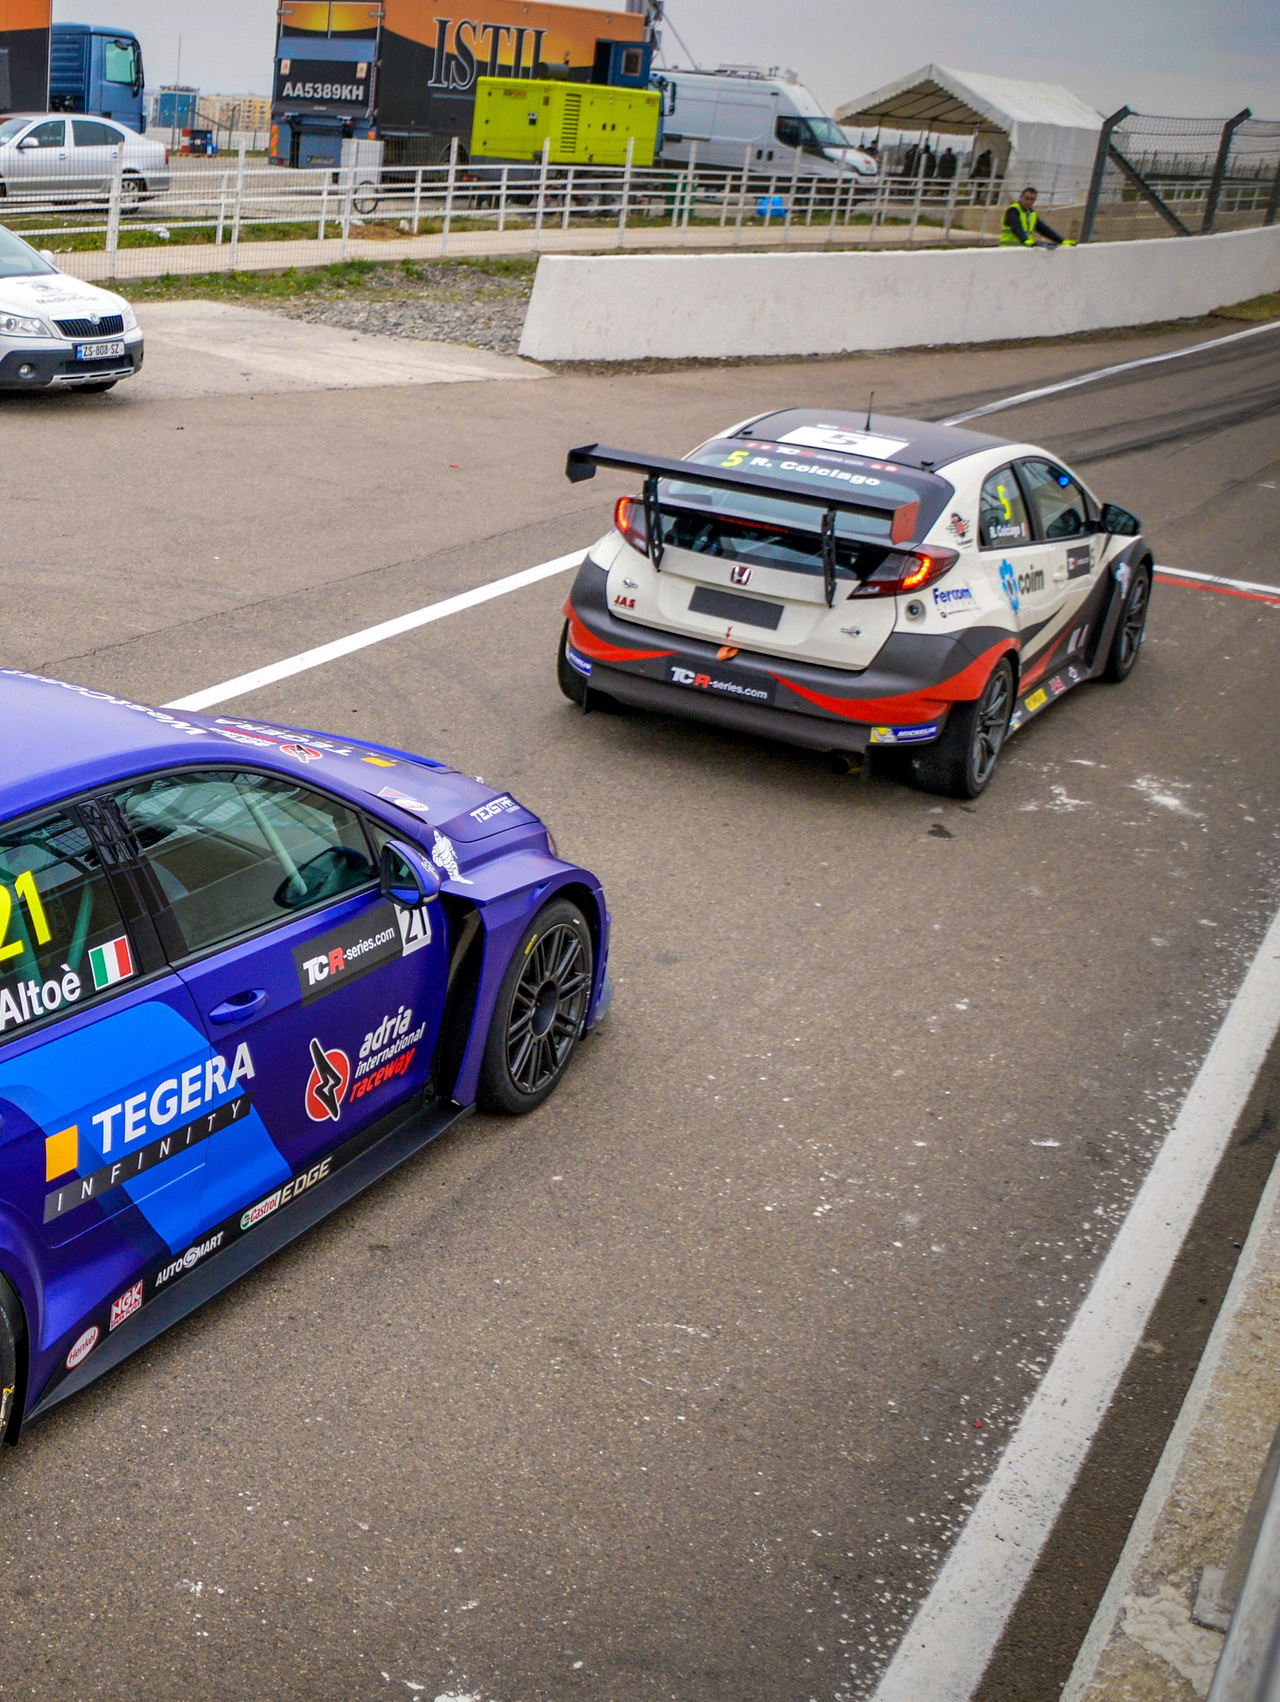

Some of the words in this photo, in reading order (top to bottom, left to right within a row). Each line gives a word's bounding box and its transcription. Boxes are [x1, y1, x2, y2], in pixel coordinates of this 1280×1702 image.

[282, 82, 364, 100] AA5389KH
[83, 344, 120, 357] ZS-808-SZ
[721, 450, 750, 468] 5
[750, 457, 772, 467] R.
[780, 461, 881, 486] Colciago
[997, 485, 1011, 520] 5
[670, 666, 768, 699] TCR-series.com
[398, 908, 428, 946] 21
[302, 927, 396, 986] TCR-series.com
[354, 1021, 426, 1079] international
[359, 1005, 412, 1058] adria
[349, 1047, 416, 1103] raceway
[92, 1042, 256, 1155] TEGERA
[56, 1099, 243, 1212] INFINITY
[249, 1194, 278, 1223] Castrol
[280, 1156, 333, 1205] EDGE
[155, 1231, 224, 1287] AUTOSMART
[112, 1284, 141, 1321] NGK
